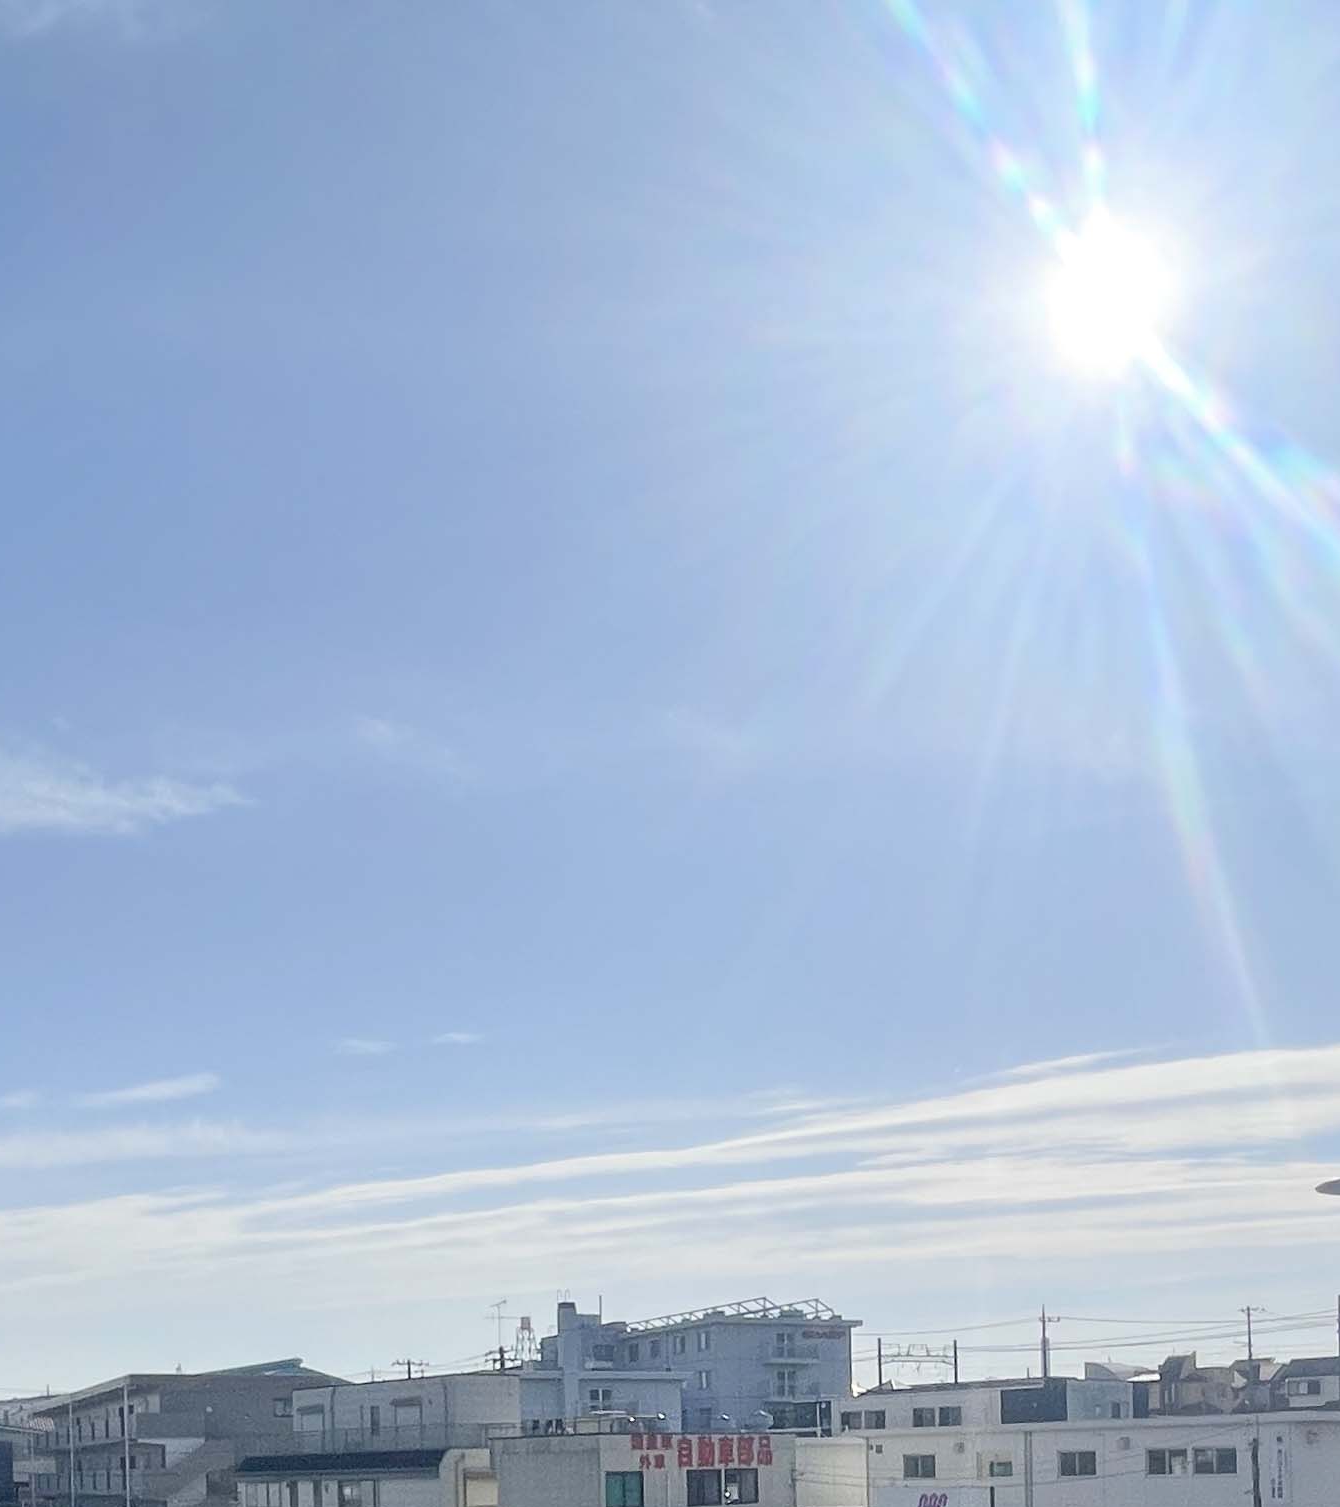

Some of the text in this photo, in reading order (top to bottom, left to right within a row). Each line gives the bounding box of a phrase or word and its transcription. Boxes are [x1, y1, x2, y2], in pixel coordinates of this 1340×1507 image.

[677, 1435, 773, 1467] 自動車部品
